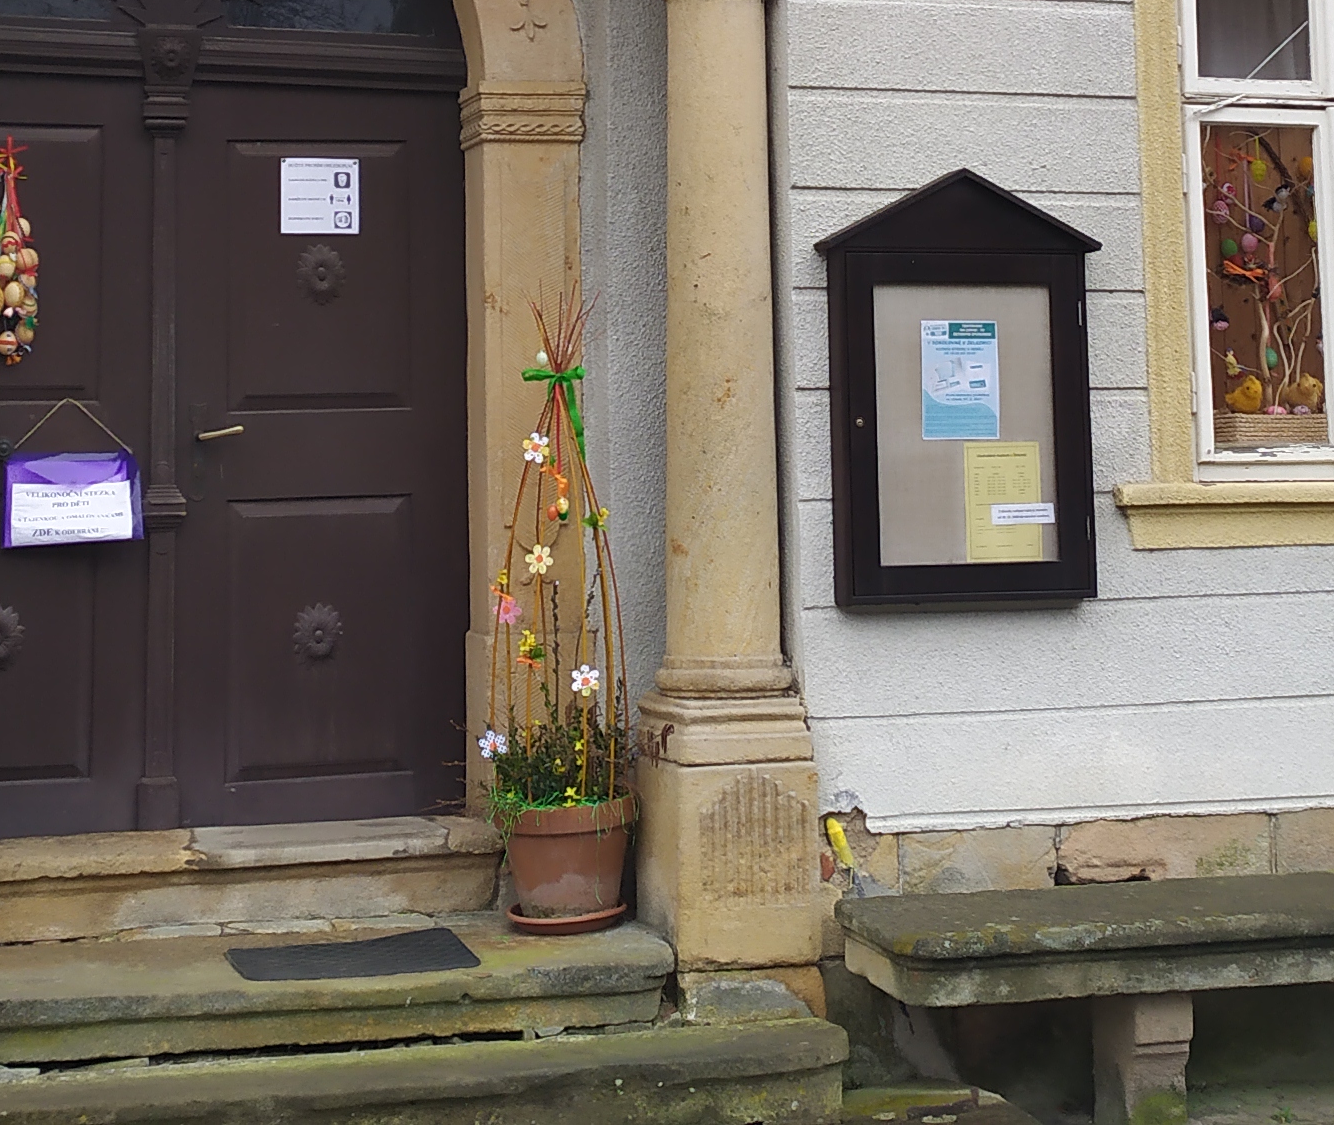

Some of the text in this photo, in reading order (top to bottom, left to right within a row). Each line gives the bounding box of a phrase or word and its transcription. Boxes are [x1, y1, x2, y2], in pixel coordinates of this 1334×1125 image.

[25, 489, 82, 498] VELIKONOČNÍ
[70, 500, 90, 508] DĚTI
[32, 528, 54, 537] ZDE
